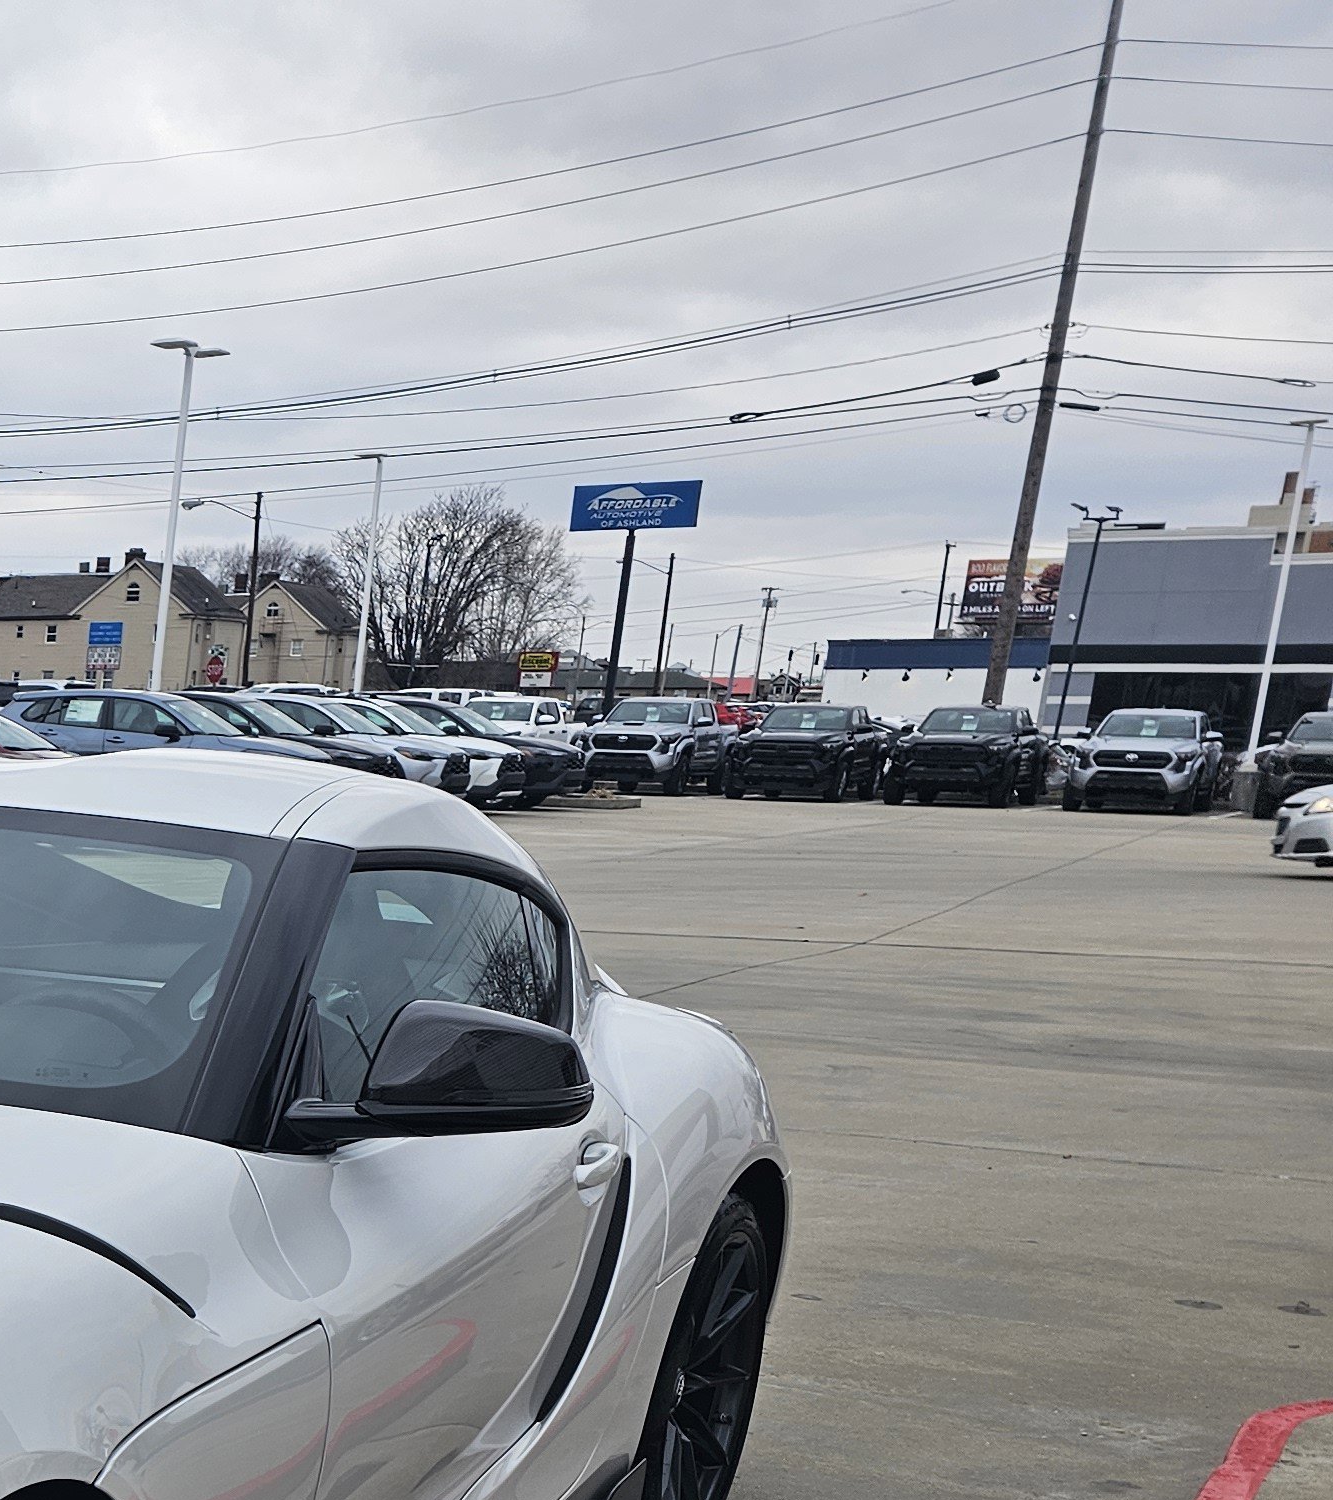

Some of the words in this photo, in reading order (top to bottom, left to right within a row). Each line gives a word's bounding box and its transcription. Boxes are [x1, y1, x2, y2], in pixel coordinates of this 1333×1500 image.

[587, 498, 677, 511] AFFORDABLE
[590, 510, 663, 519] AUTOMOTIVE
[600, 520, 614, 528] OF
[616, 518, 662, 528] ASHLAND
[968, 581, 1033, 593] OUTBK
[969, 605, 993, 613] MILES
[1035, 604, 1056, 614] LEFT
[207, 664, 223, 675] STOP
